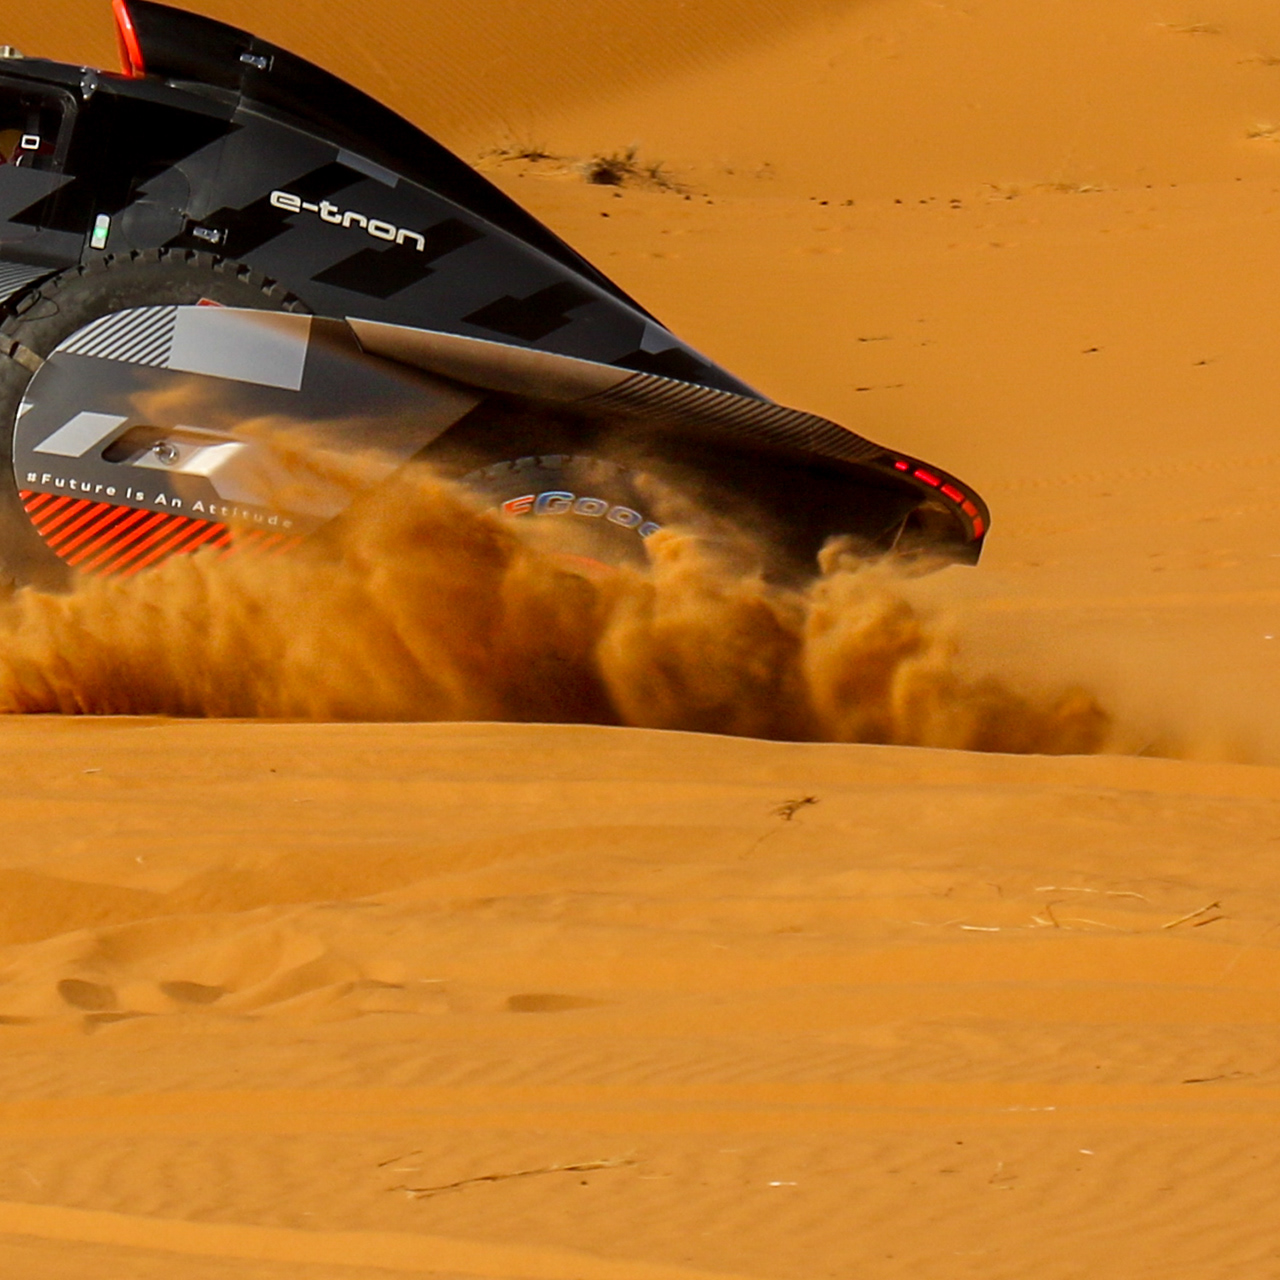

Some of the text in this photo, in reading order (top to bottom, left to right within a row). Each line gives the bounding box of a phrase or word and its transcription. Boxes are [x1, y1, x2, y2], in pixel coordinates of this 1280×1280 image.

[269, 190, 426, 252] e-tron
[26, 472, 293, 528] #Future Is An Attitude
